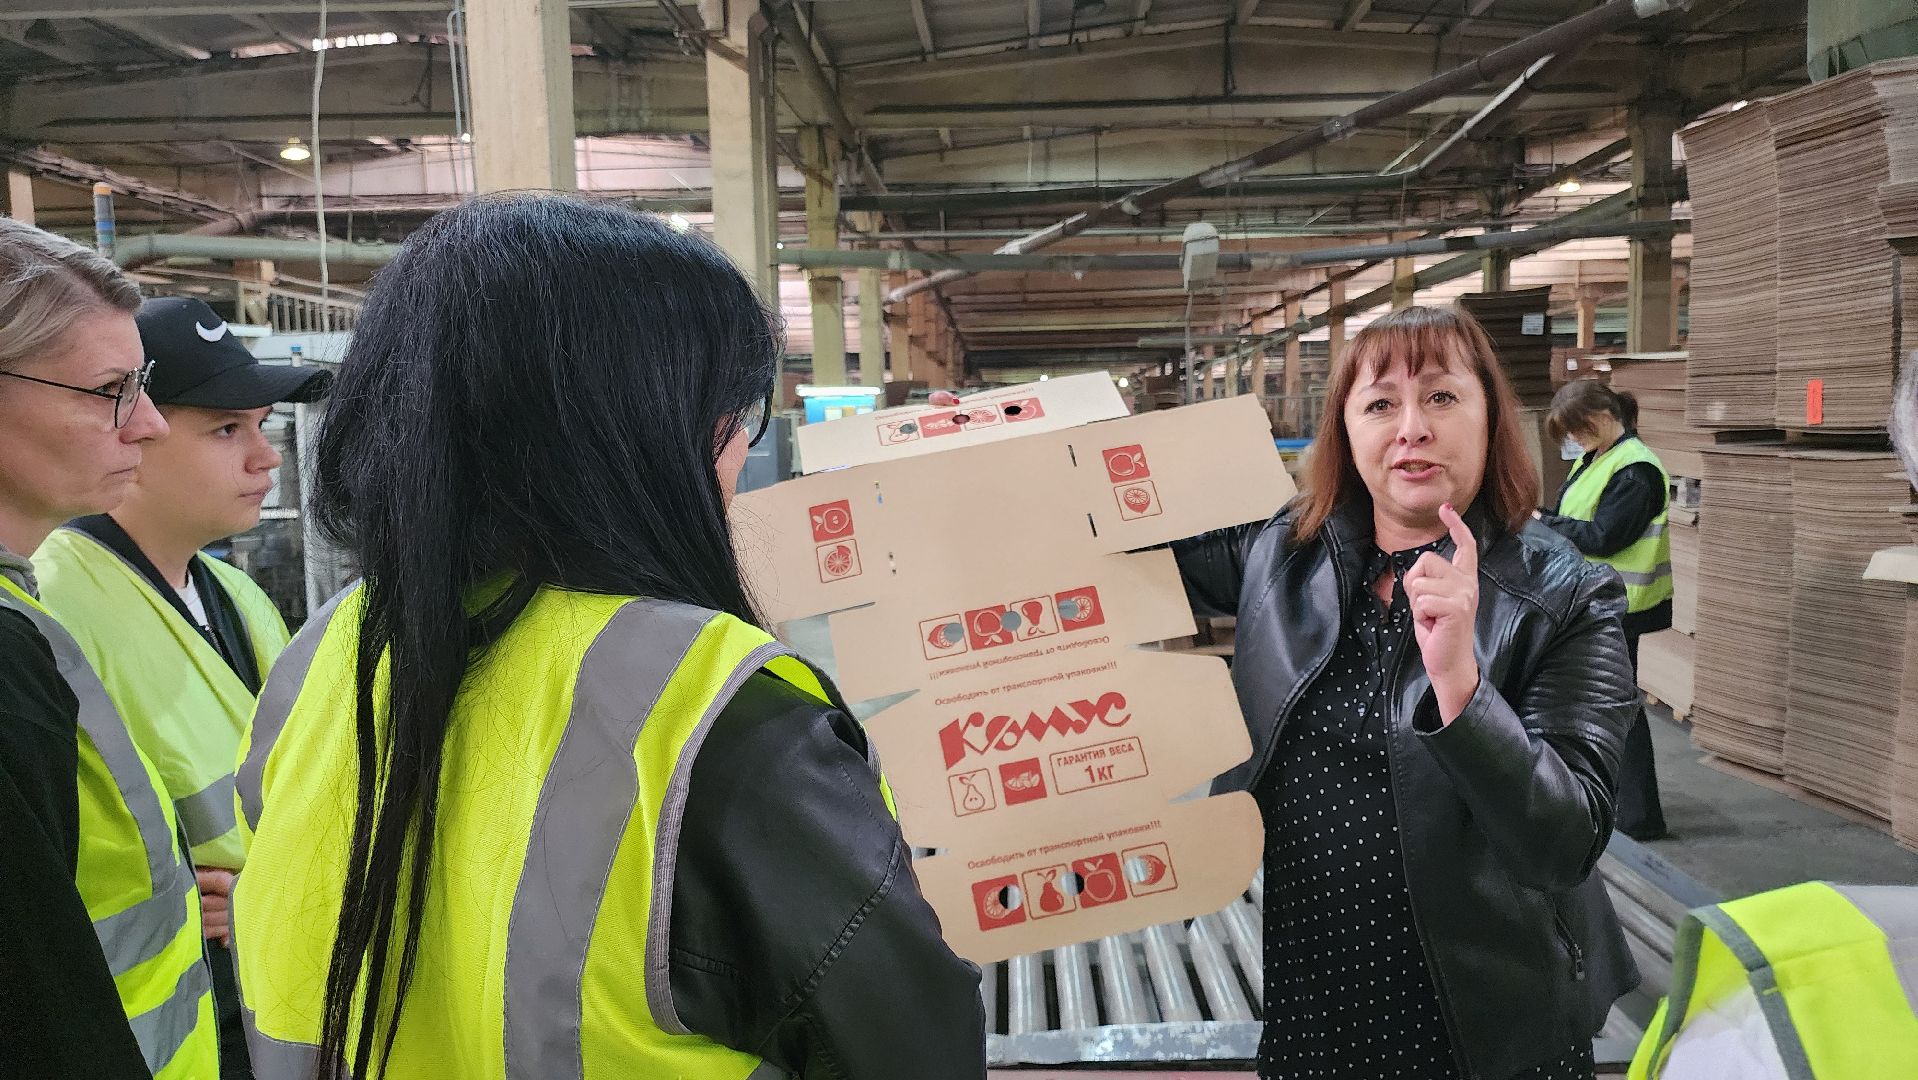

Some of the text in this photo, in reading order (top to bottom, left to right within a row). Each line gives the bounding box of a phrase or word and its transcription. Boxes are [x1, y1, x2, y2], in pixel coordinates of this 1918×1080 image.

[1046, 647, 1055, 655] от
[1057, 635, 1110, 653] Освободить
[982, 649, 1044, 669] транспортной
[935, 689, 988, 706] Освободить
[990, 687, 1000, 695] от
[1002, 672, 1065, 693] транспортной
[1056, 743, 1135, 767] ГАРАНТИЯ ВЕСА
[967, 852, 1025, 870] Освободить
[1026, 848, 1037, 857] от
[1039, 832, 1105, 856] транспортной
